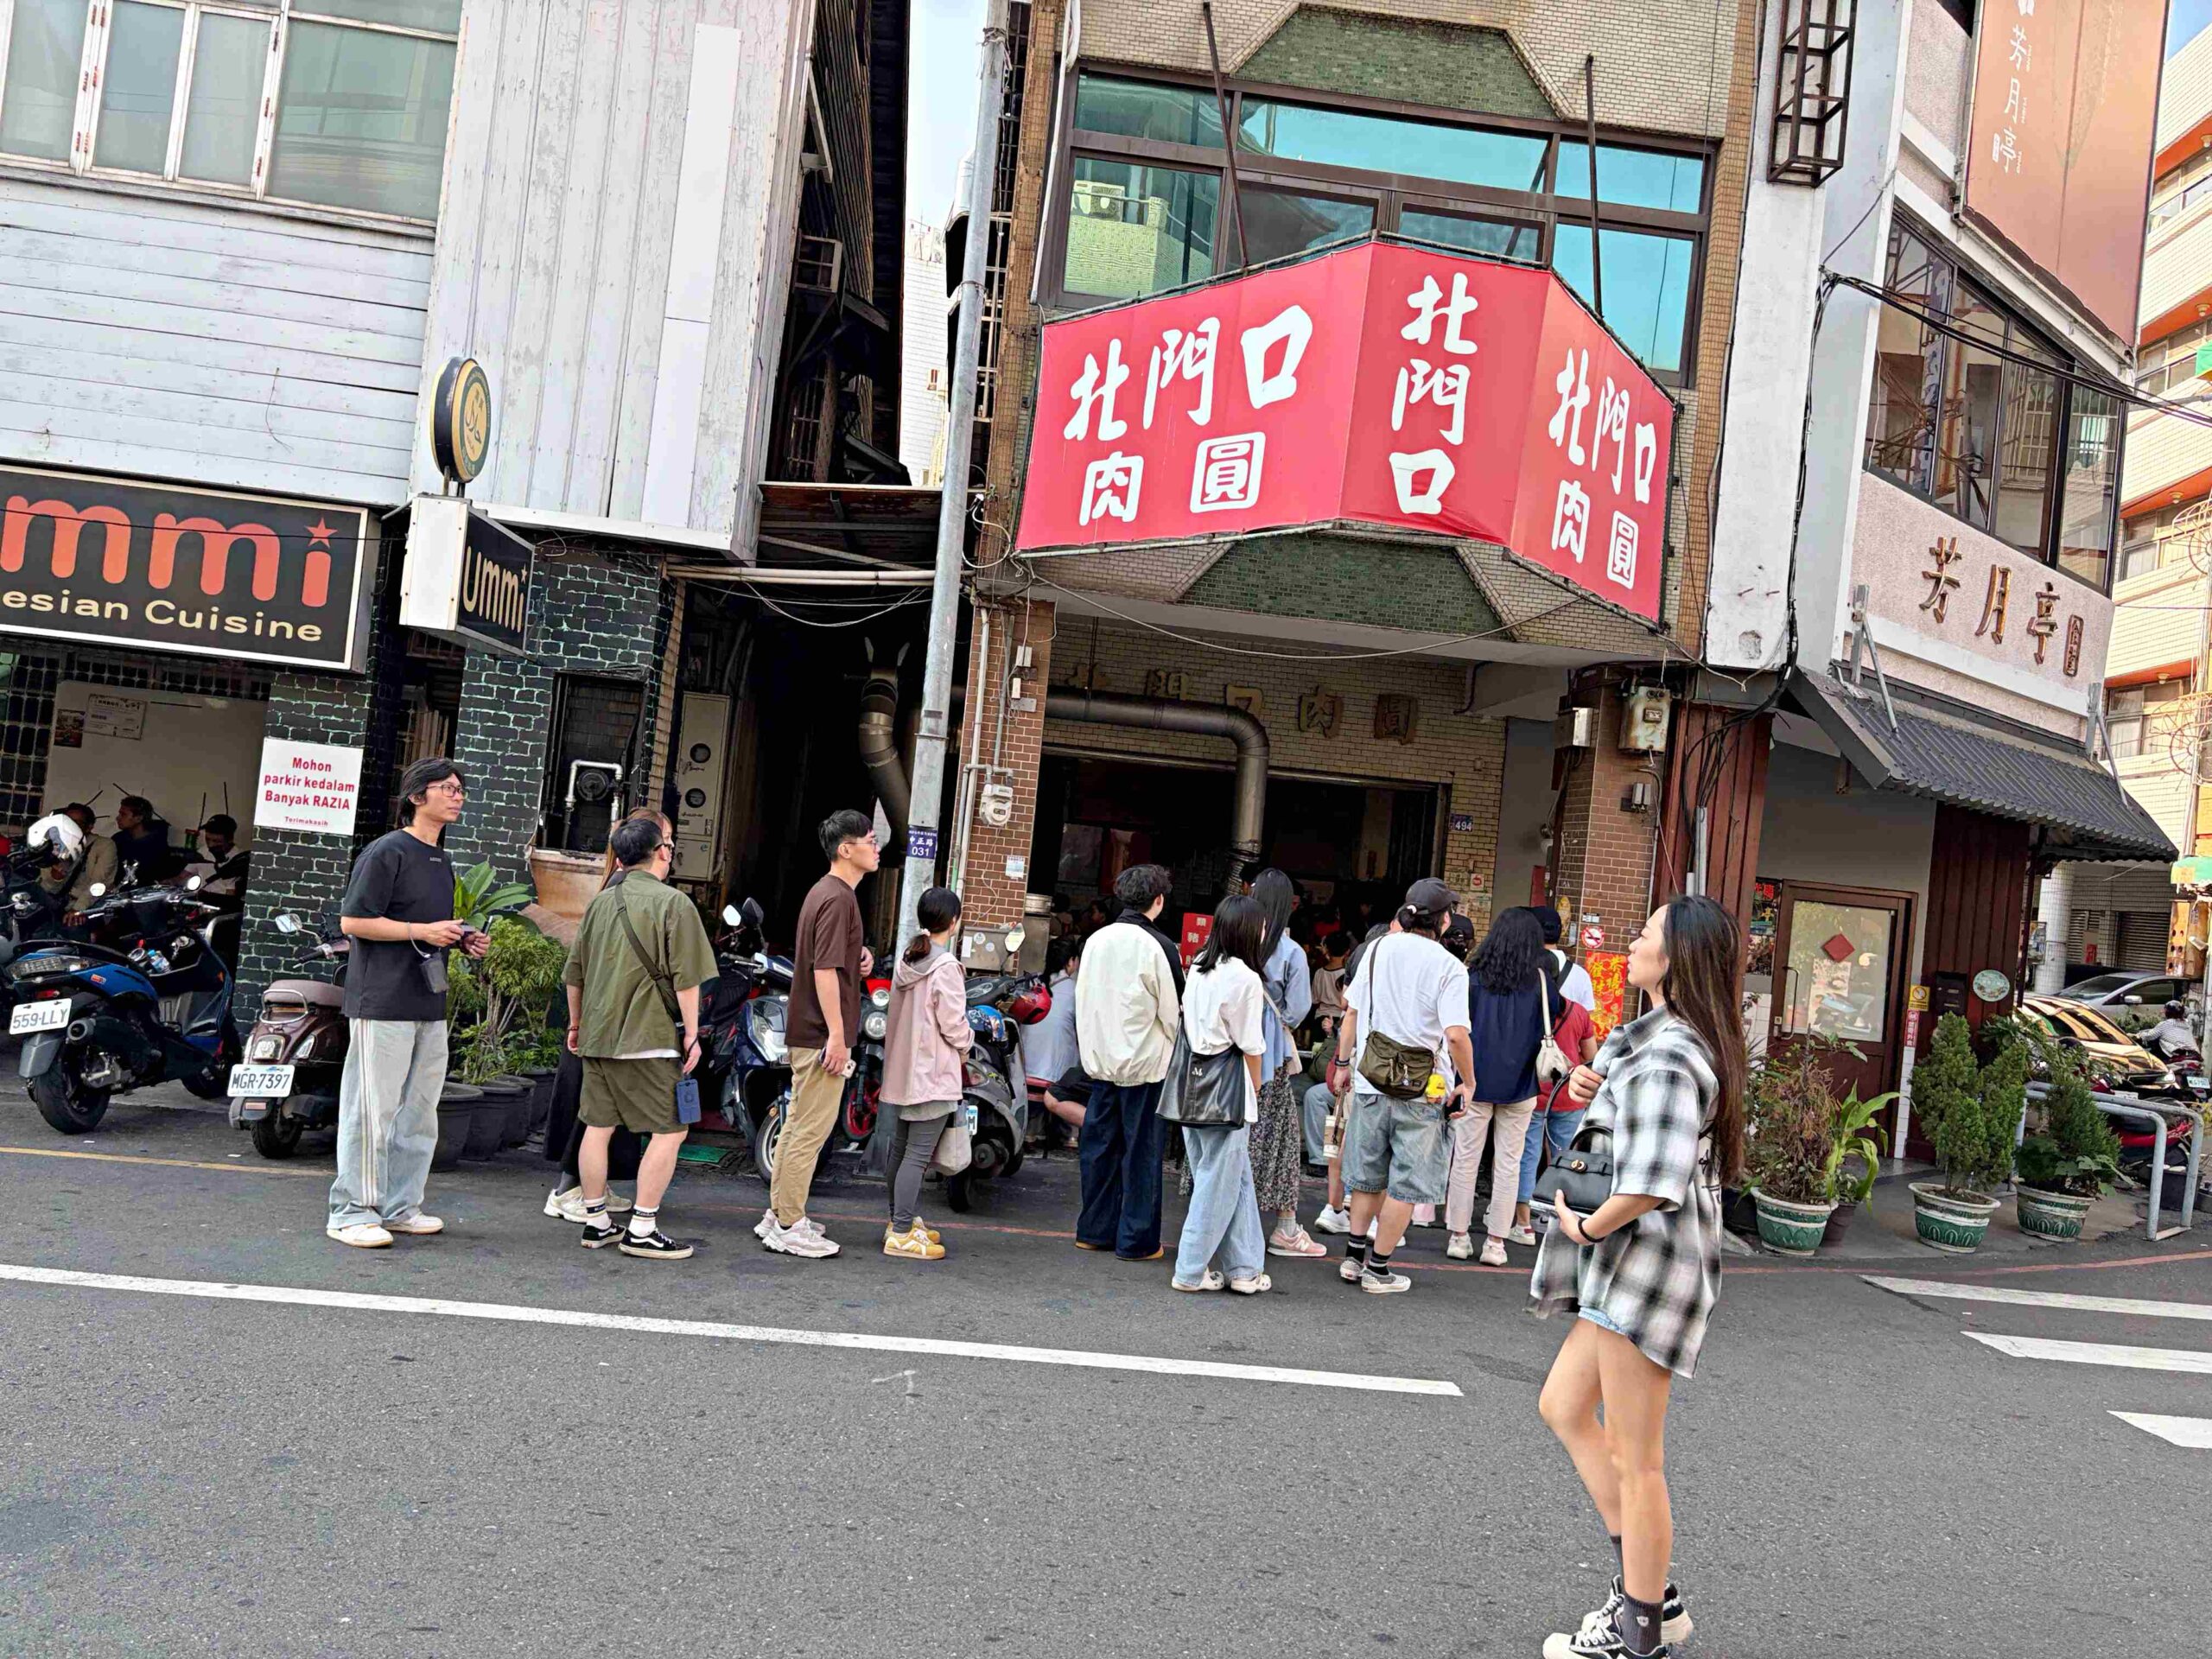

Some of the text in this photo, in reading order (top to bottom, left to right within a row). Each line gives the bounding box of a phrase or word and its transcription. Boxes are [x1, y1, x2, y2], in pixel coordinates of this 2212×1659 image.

[1999, 23, 2028, 174] 芳月亭
[1063, 304, 1313, 442] 北門口
[1389, 271, 1478, 515] 北門口
[1548, 347, 1657, 505] 北門口
[1078, 431, 1267, 526] 肉圓
[1551, 480, 1639, 590] 肉圓
[3, 589, 322, 642] esian Cuisine
[462, 545, 528, 633] Ummi
[1918, 537, 2061, 664] 芳月亭
[264, 774, 355, 792] parkir kedalam
[264, 790, 350, 810] Banyak RAZIA
[292, 757, 332, 772] Mohon
[912, 846, 930, 856] 031
[1455, 821, 1472, 831] 494
